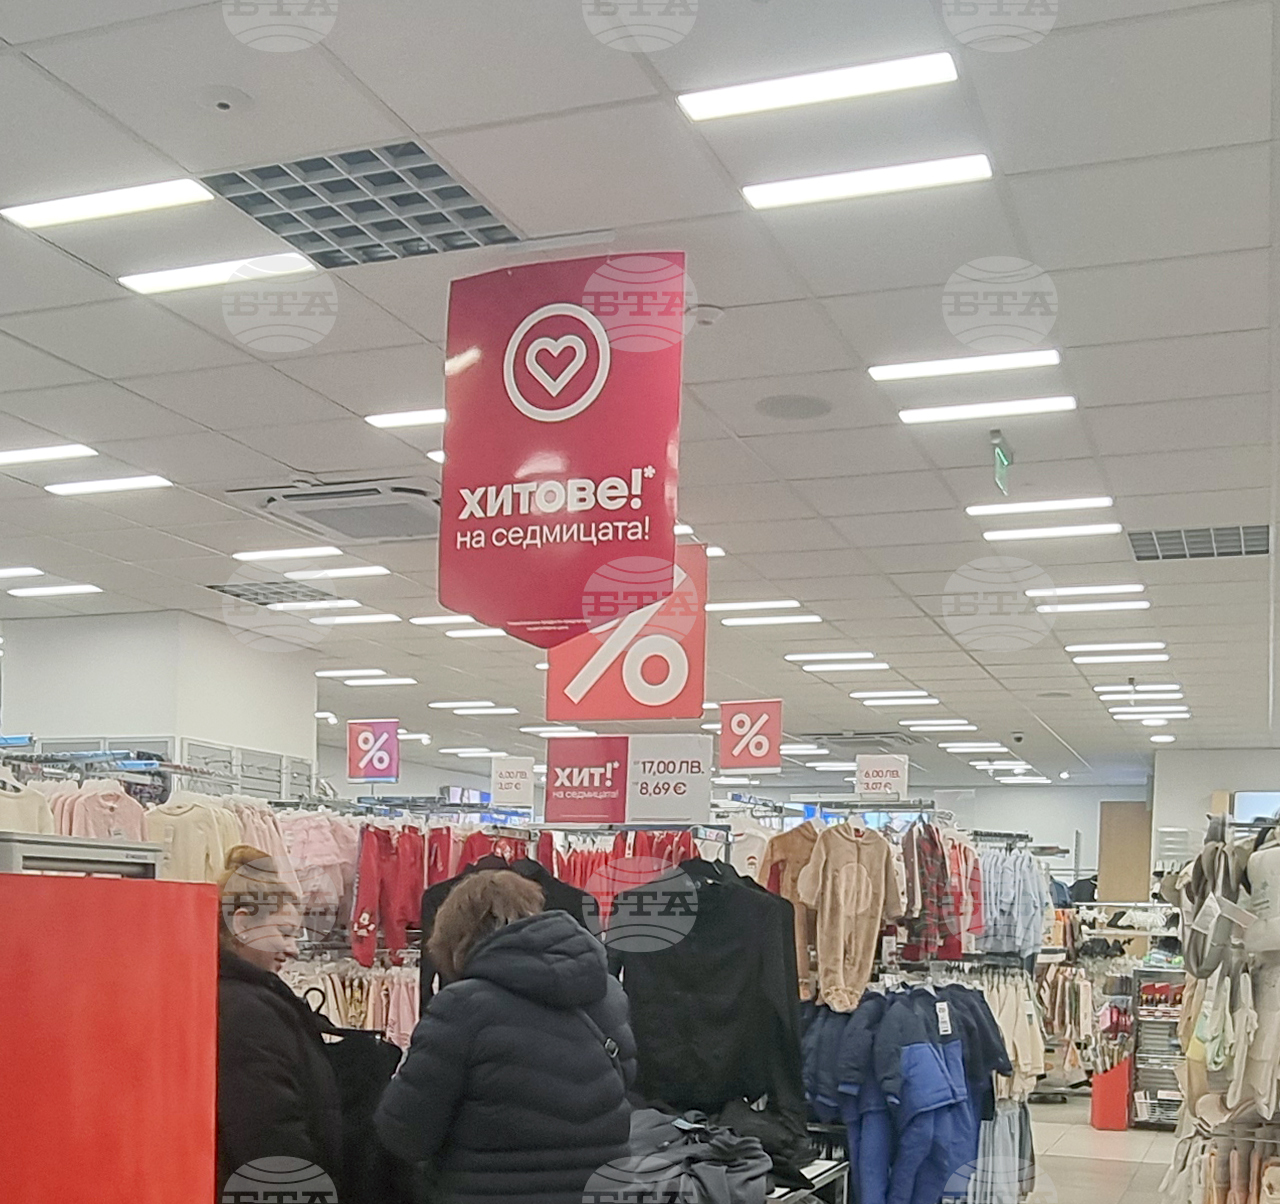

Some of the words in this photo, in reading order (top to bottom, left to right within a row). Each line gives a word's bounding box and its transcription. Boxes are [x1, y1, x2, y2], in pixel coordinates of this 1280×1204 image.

[456, 530, 486, 550] на
[492, 516, 650, 549] седмицата!
[357, 730, 390, 770] %
[730, 712, 770, 758] %
[565, 789, 619, 800] седмицата!
[639, 781, 671, 796] 8,69
